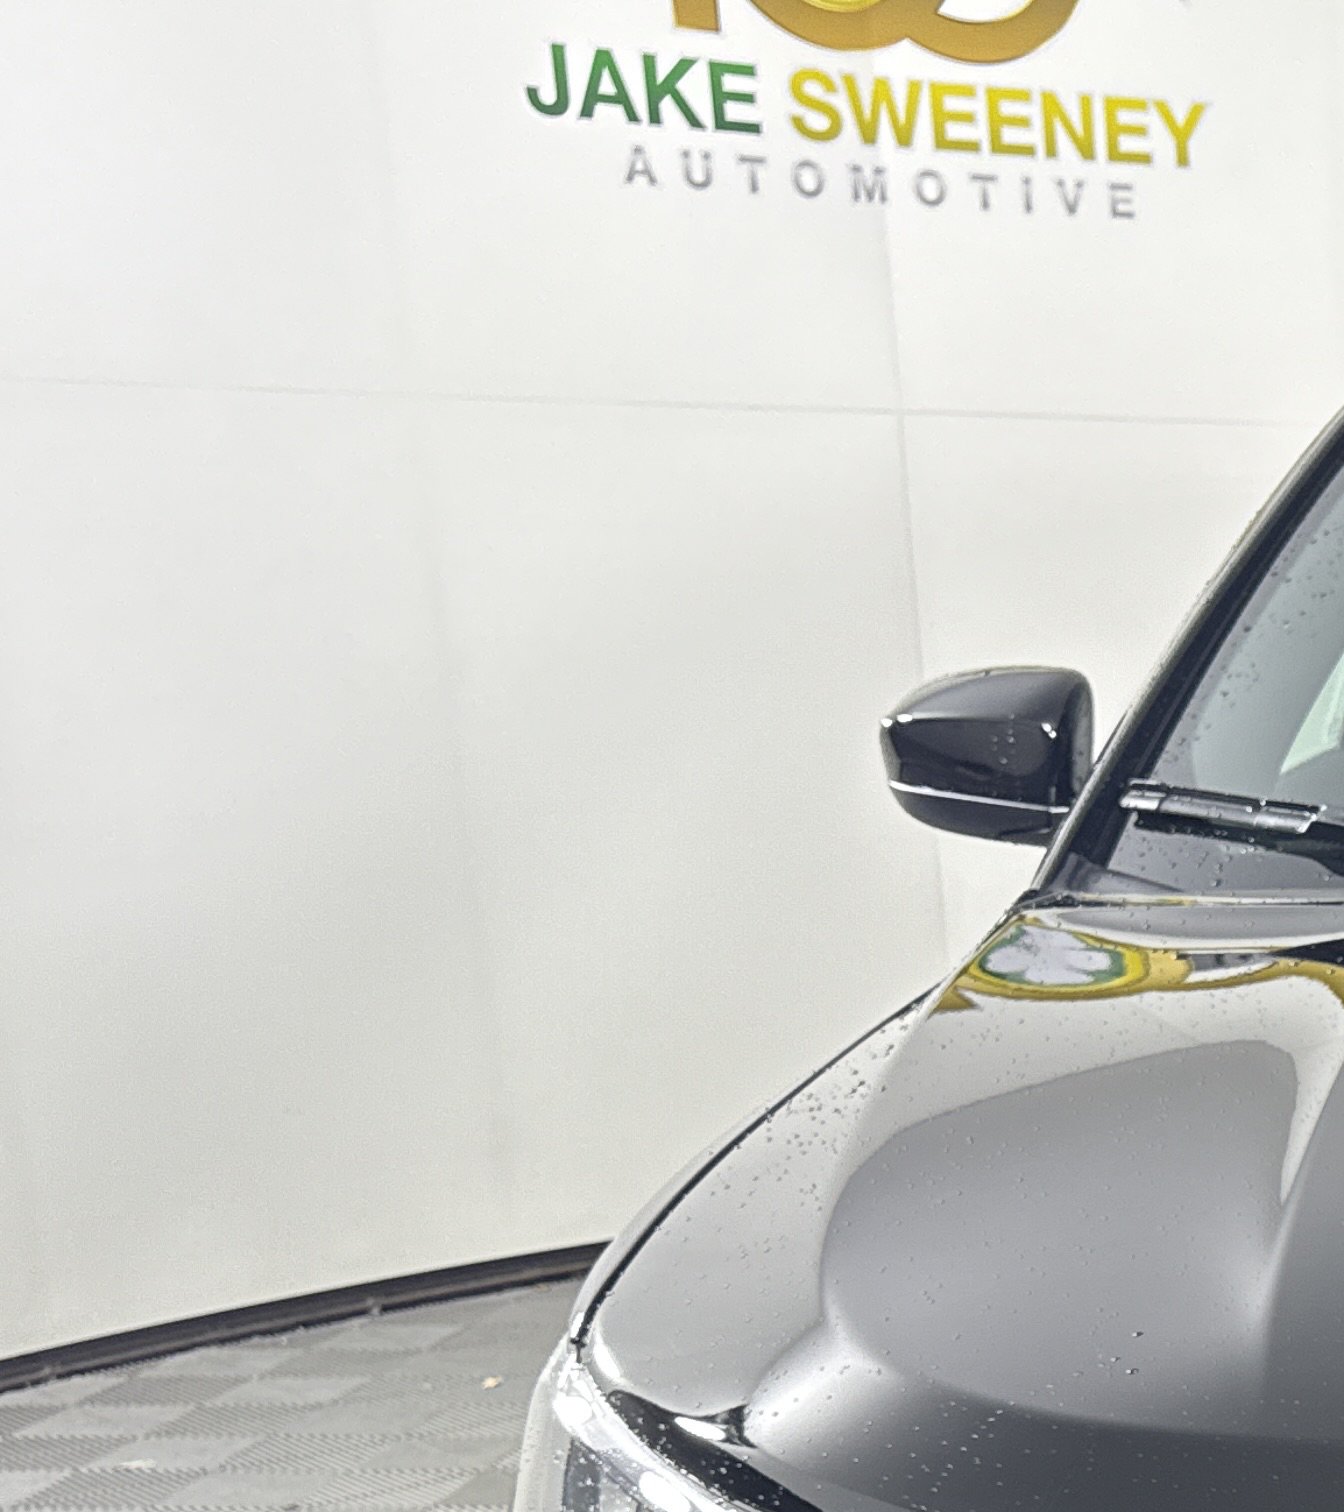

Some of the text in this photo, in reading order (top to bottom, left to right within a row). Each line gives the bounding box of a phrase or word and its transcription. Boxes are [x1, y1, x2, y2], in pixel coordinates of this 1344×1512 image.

[526, 43, 1206, 169] JAKE SWEENEY
[624, 145, 1137, 220] AUTOMOTIVE
